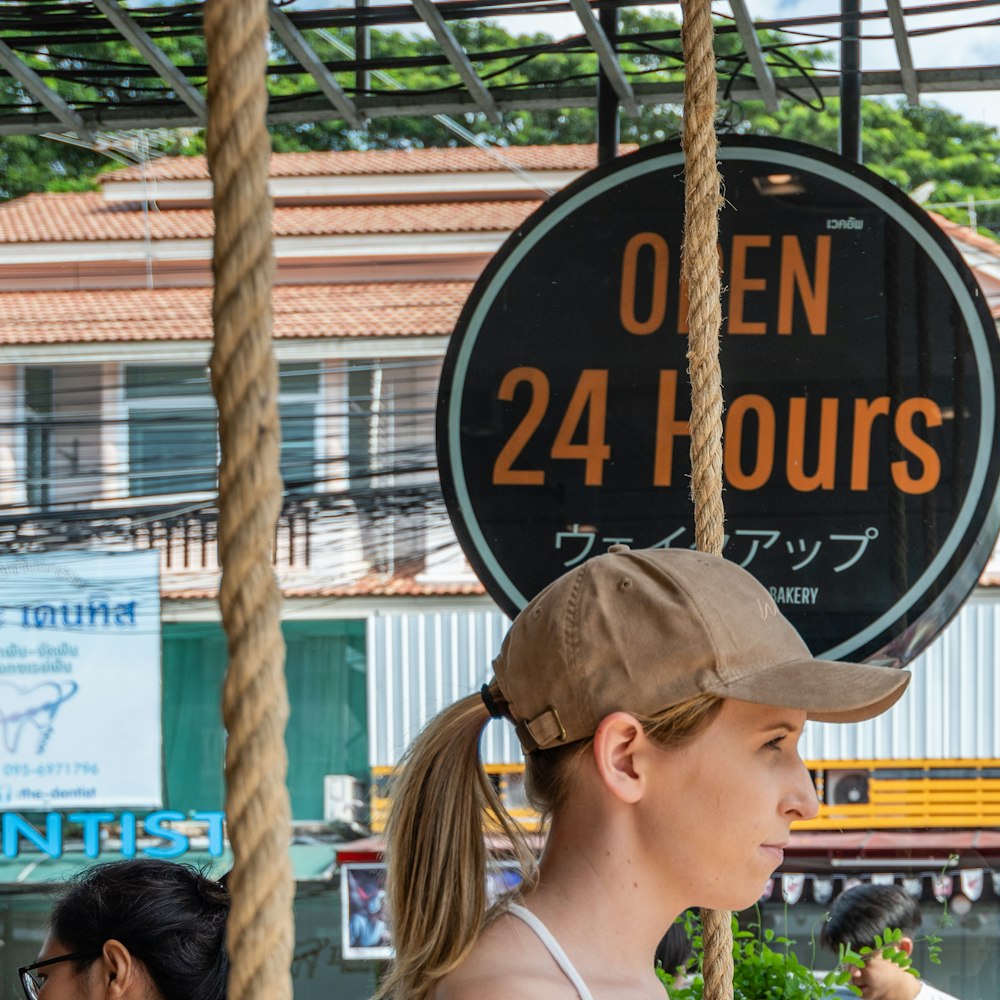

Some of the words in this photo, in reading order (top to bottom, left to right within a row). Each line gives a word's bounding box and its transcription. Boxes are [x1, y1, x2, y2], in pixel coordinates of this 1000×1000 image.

[492, 366, 611, 486] 24
[653, 369, 943, 495] Hours
[554, 524, 879, 573] ウアップ
[769, 586, 819, 605] BAKERY
[1, 811, 226, 859] NTIST
